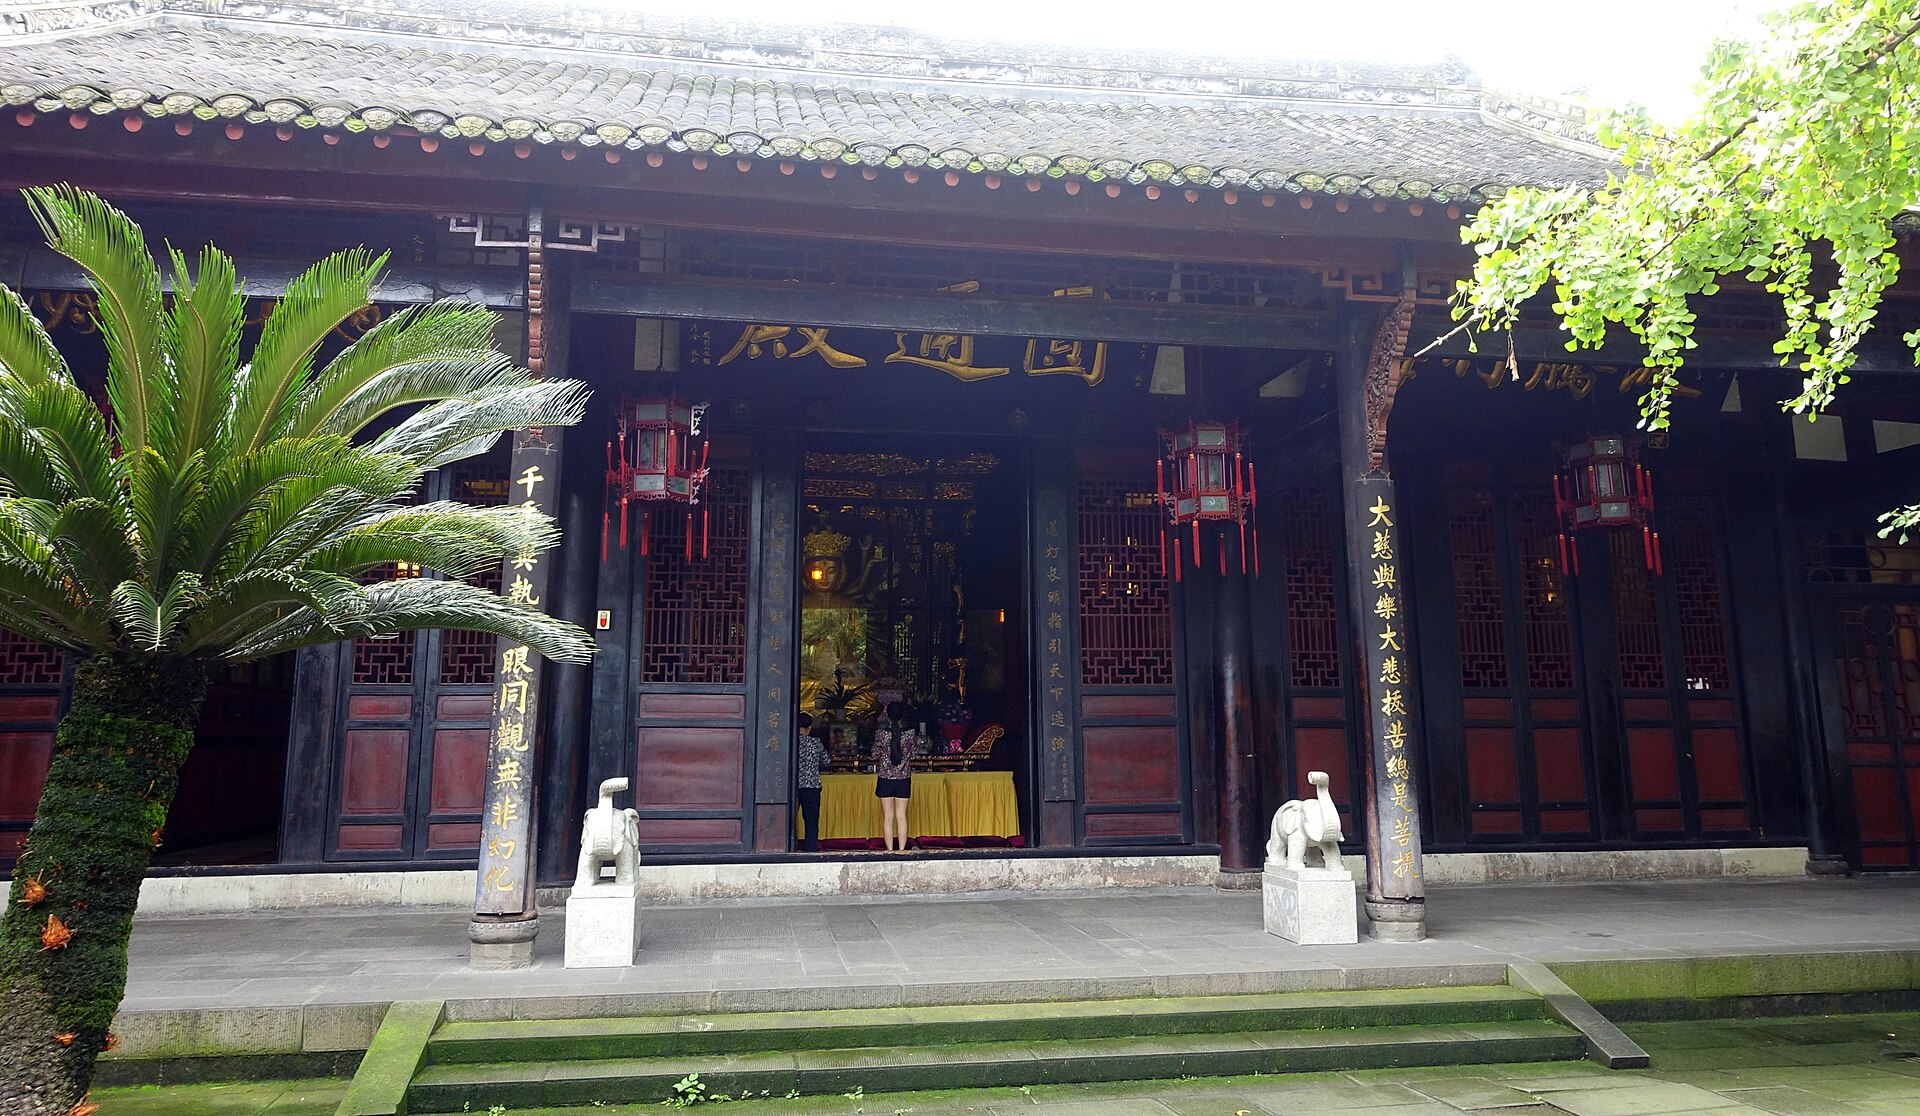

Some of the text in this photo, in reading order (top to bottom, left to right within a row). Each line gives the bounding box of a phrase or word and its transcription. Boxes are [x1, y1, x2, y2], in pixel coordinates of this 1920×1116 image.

[484, 465, 545, 894] 千執眼同觀無非幻化
